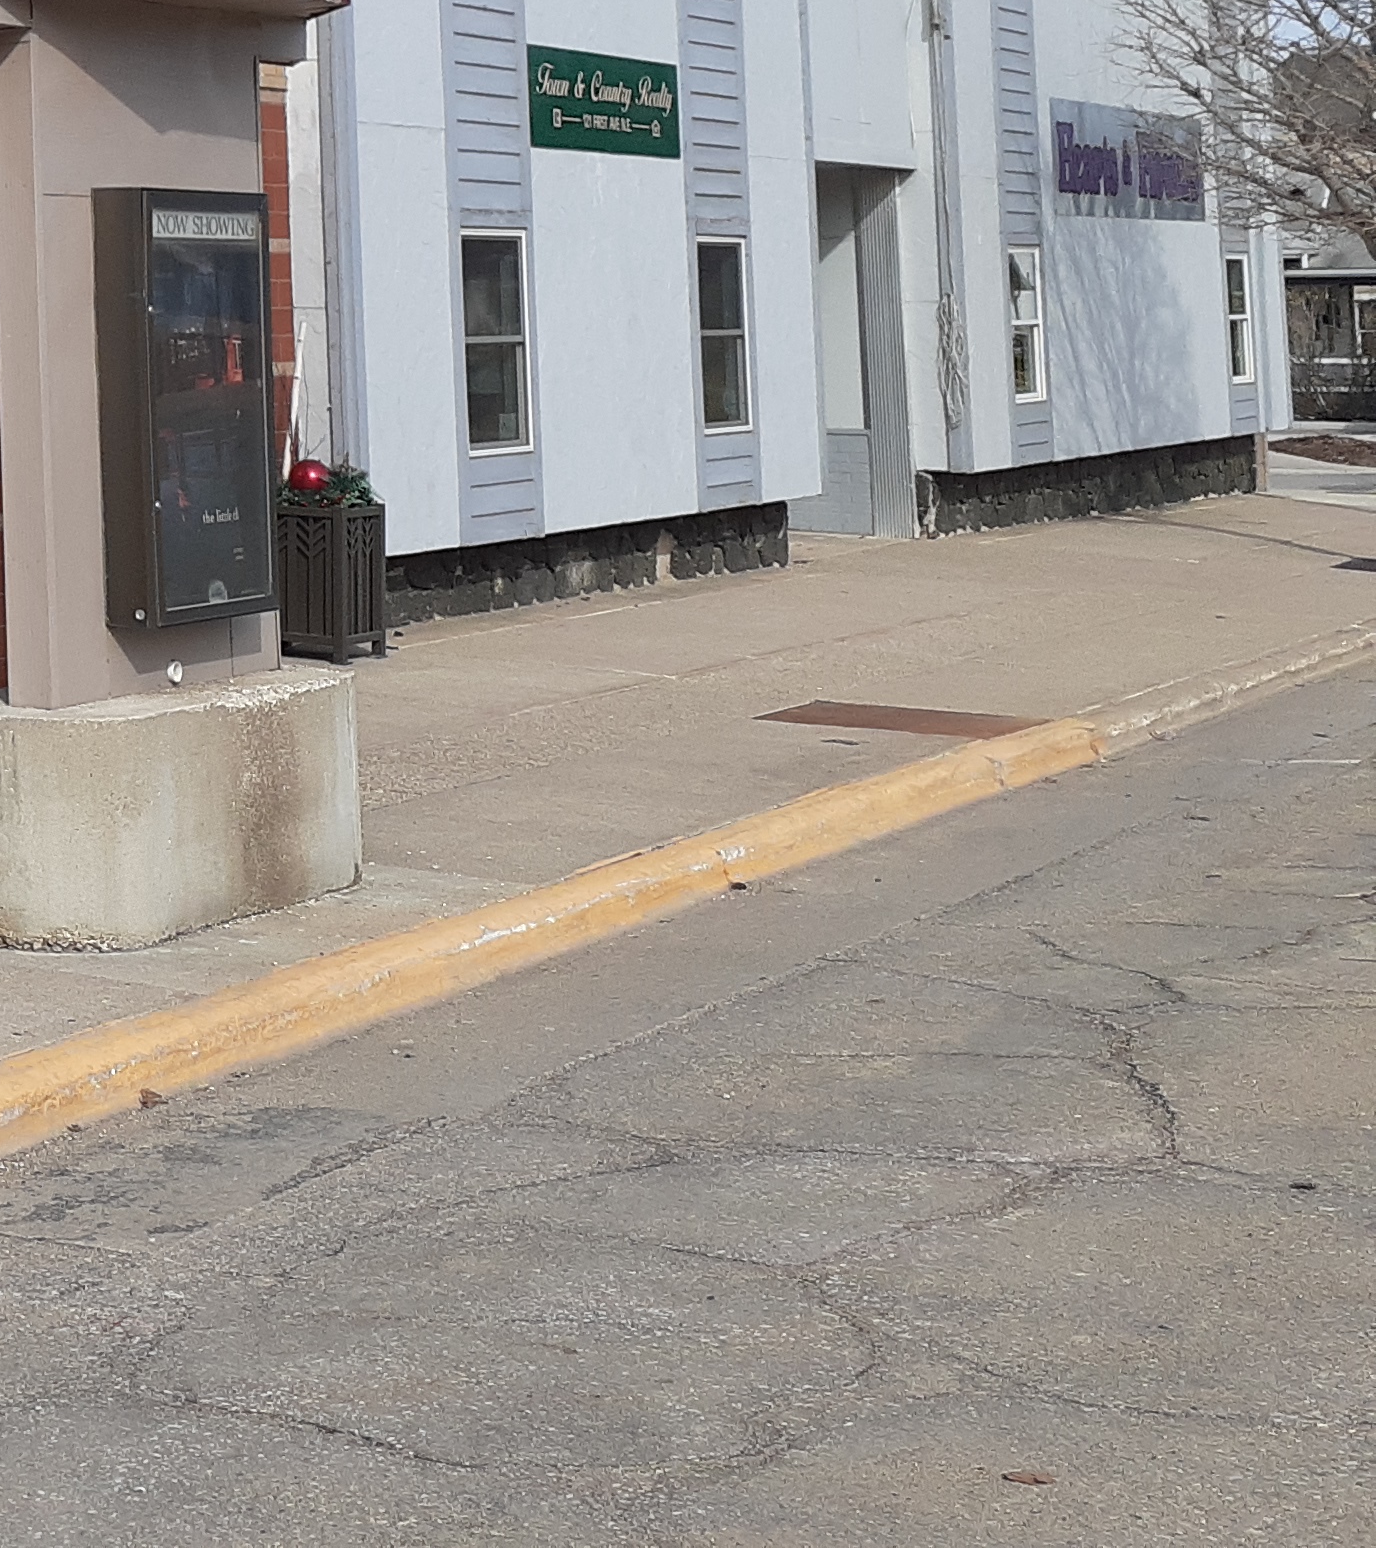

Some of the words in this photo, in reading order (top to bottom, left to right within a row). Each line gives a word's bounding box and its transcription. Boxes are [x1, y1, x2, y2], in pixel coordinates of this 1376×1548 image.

[535, 62, 570, 97] Town
[574, 71, 586, 99] &
[590, 70, 633, 113] Country
[635, 75, 674, 118] Realty
[156, 213, 189, 235] NOW
[192, 215, 255, 237] SHOWING
